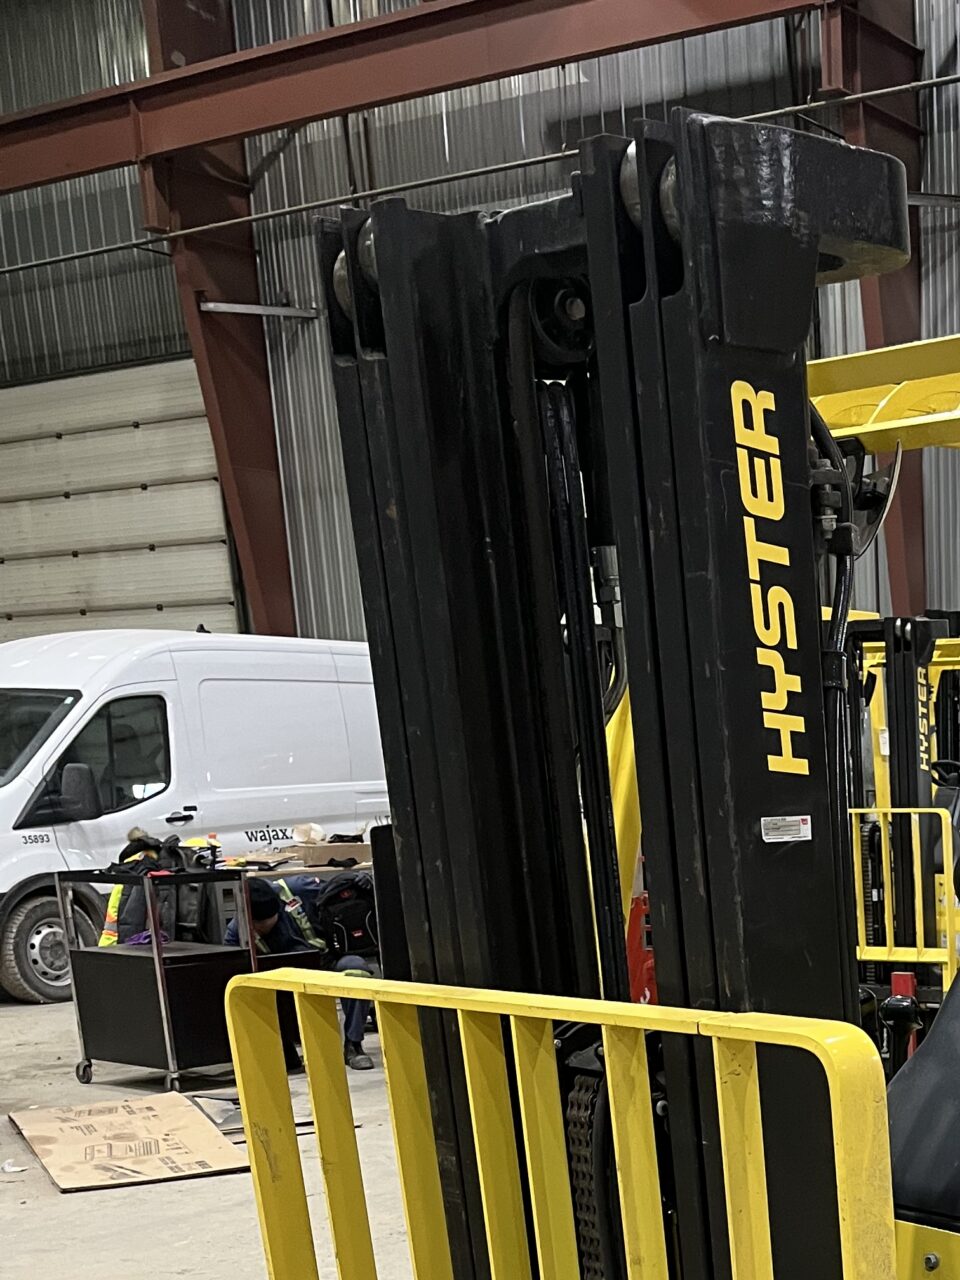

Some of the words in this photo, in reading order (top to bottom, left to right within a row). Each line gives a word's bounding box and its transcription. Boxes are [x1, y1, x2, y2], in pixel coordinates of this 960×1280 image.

[730, 379, 810, 776] HYSTER
[917, 666, 930, 772] HYSTER
[21, 833, 51, 845] 35893
[244, 824, 294, 845] wajax.
